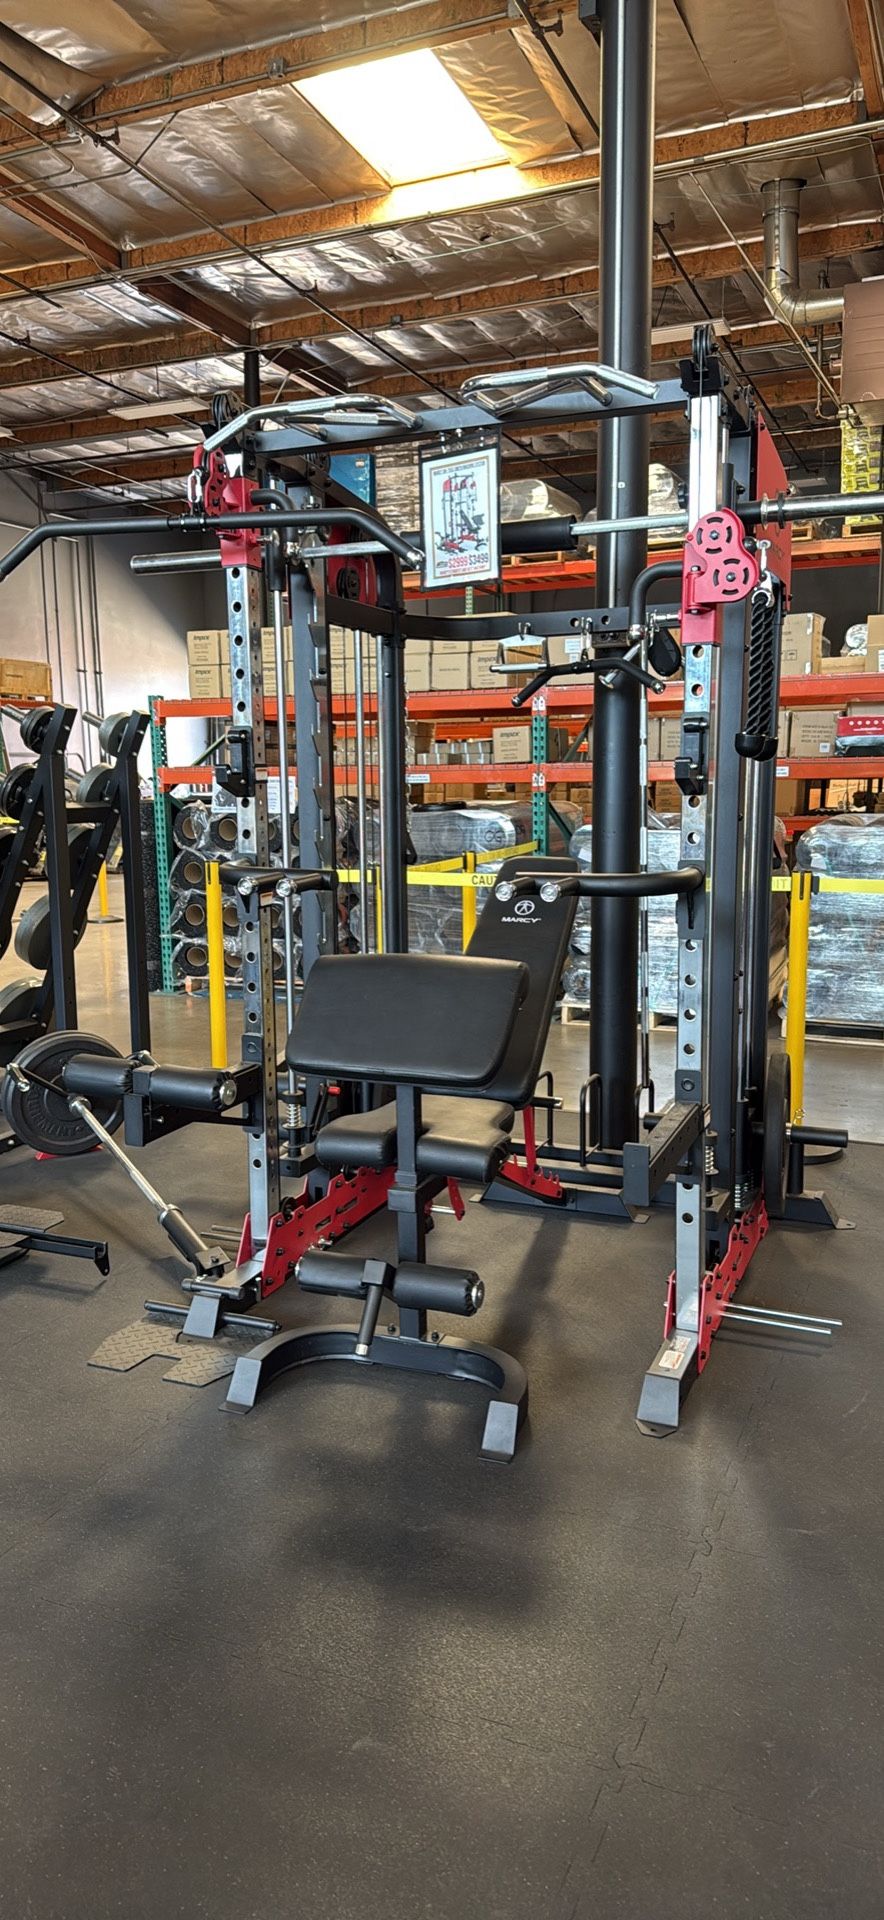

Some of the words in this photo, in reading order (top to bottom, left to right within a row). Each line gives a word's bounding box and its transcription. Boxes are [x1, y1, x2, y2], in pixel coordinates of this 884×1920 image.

[469, 553, 489, 565] $3499
[471, 875, 497, 886] CAU
[501, 916, 540, 924] MARCY
